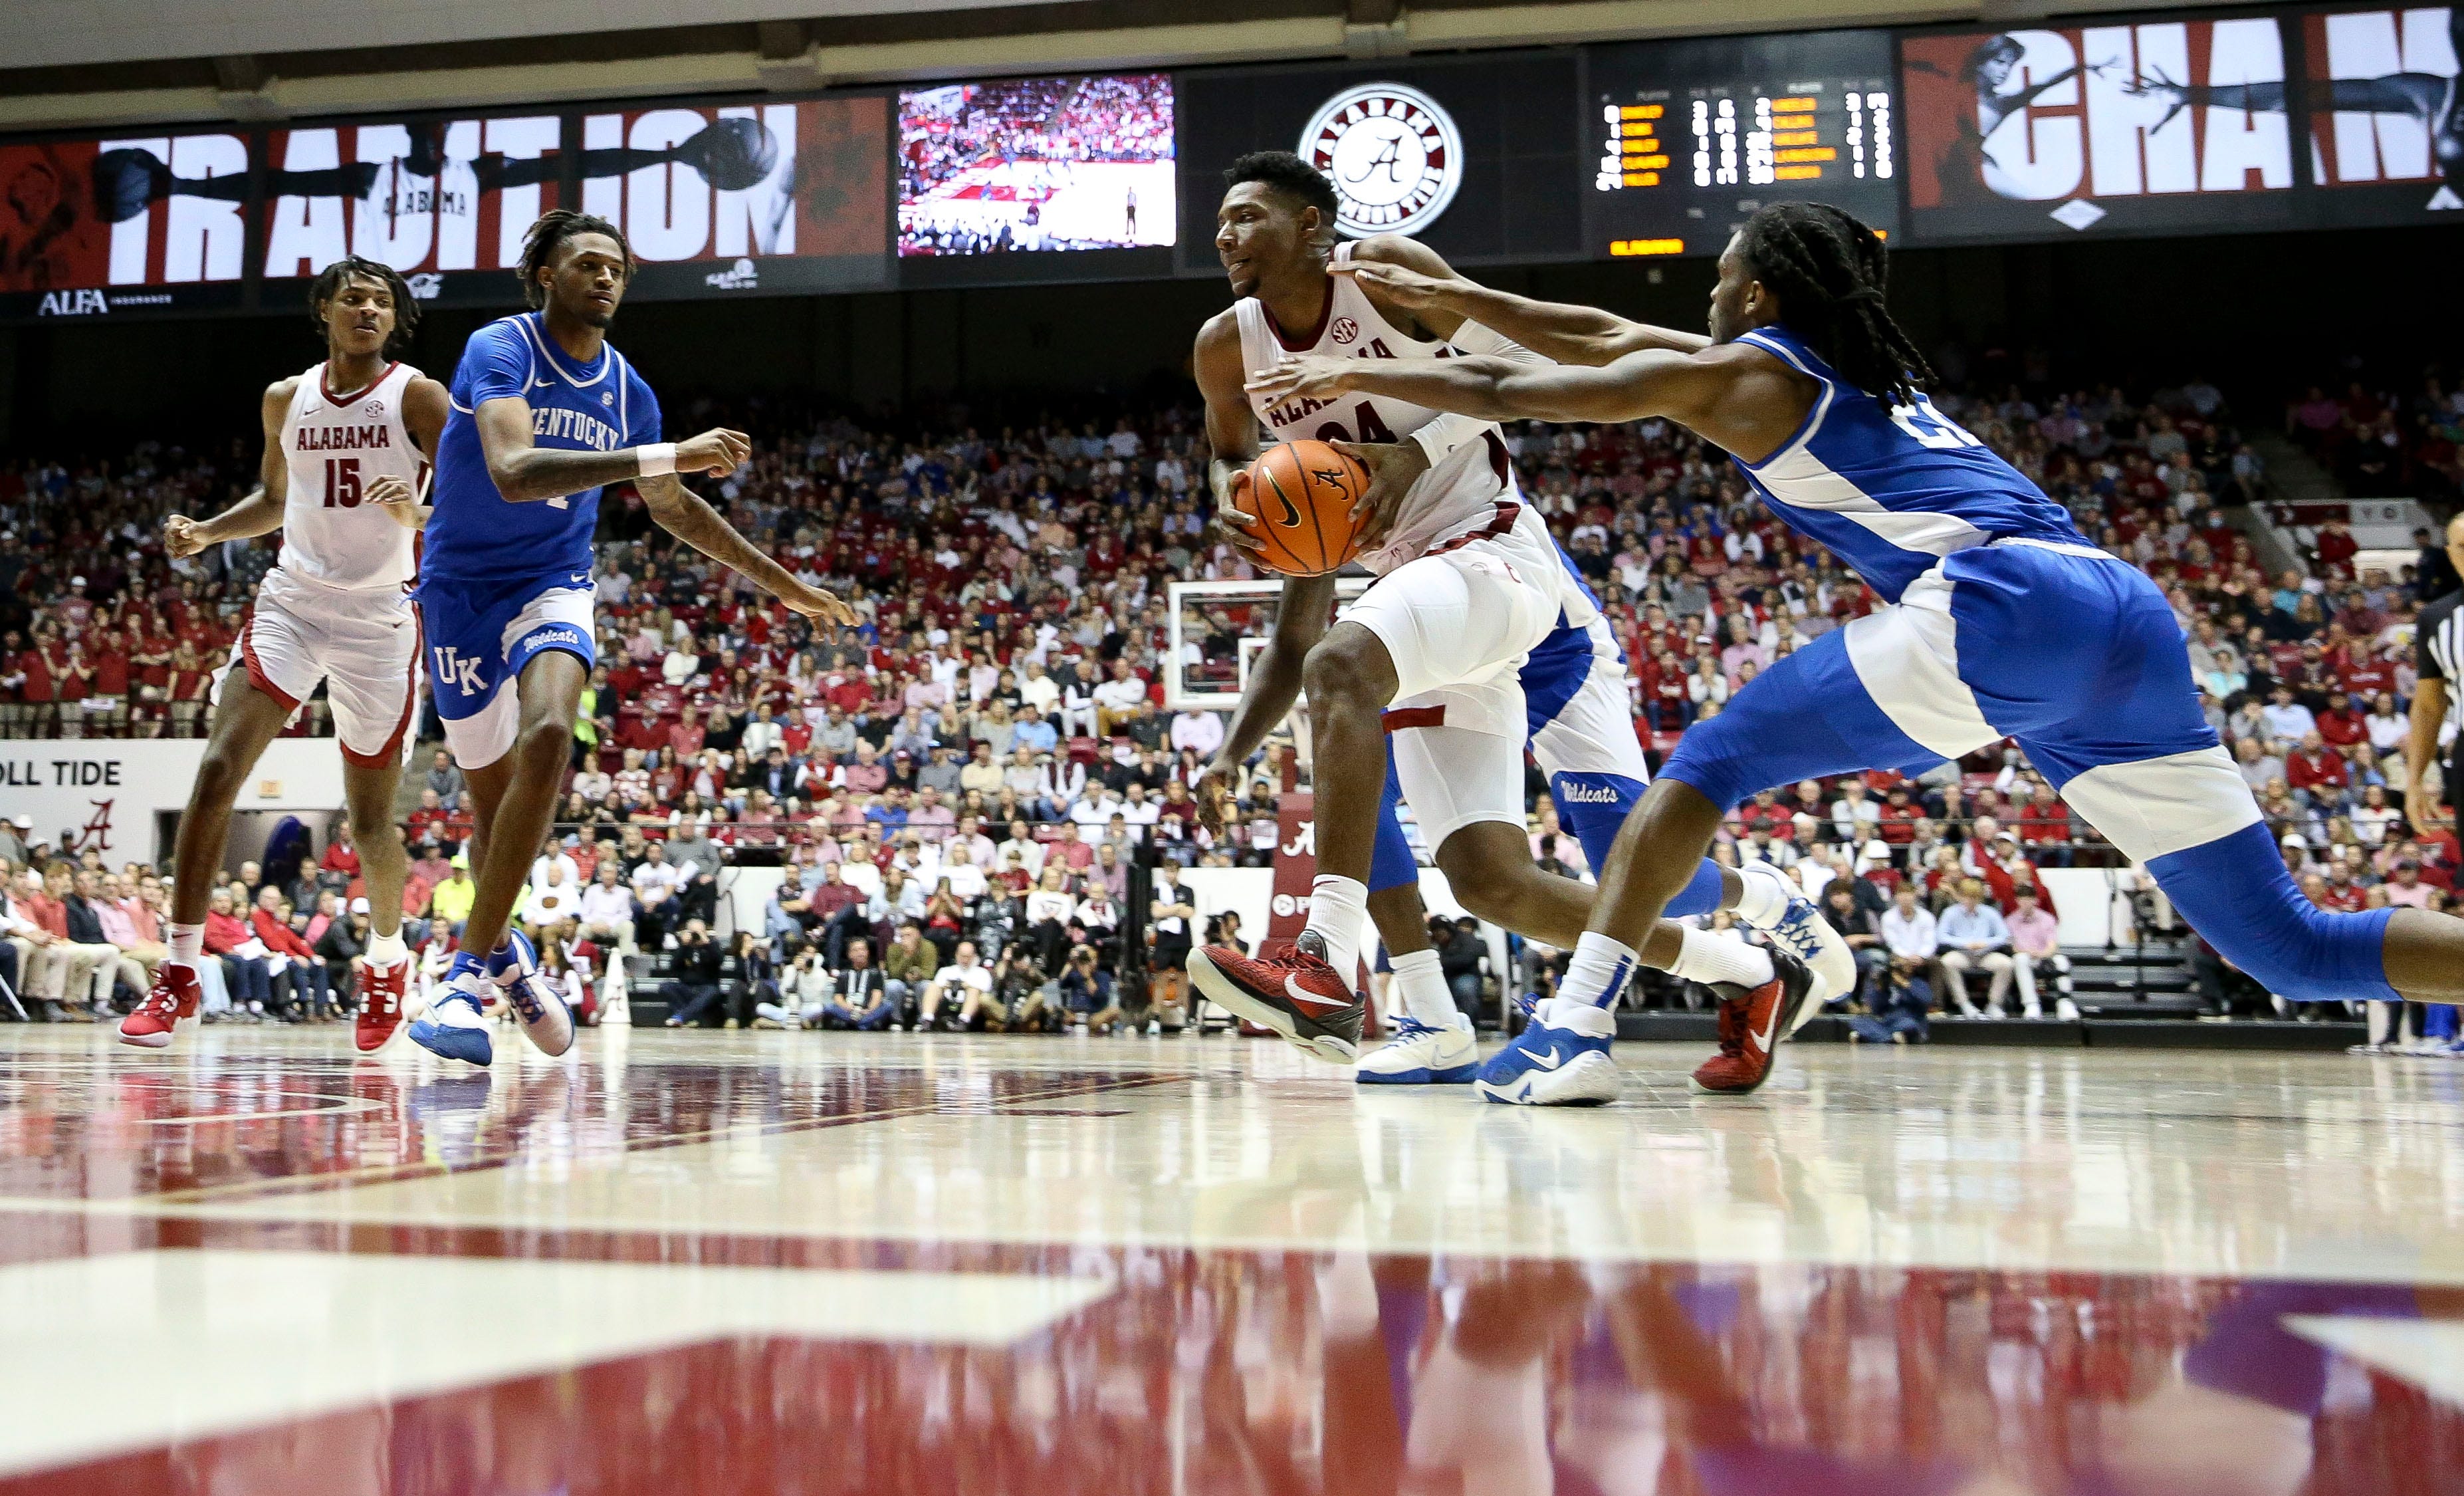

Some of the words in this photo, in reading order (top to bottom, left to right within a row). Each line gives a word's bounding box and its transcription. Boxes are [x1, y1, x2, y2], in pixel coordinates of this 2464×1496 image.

[38, 289, 109, 316] ALFA
[296, 425, 390, 451] ALABAMA
[324, 458, 361, 508] 15
[434, 646, 489, 696] UK
[0, 761, 41, 785] LL
[52, 761, 121, 785] TIDE
